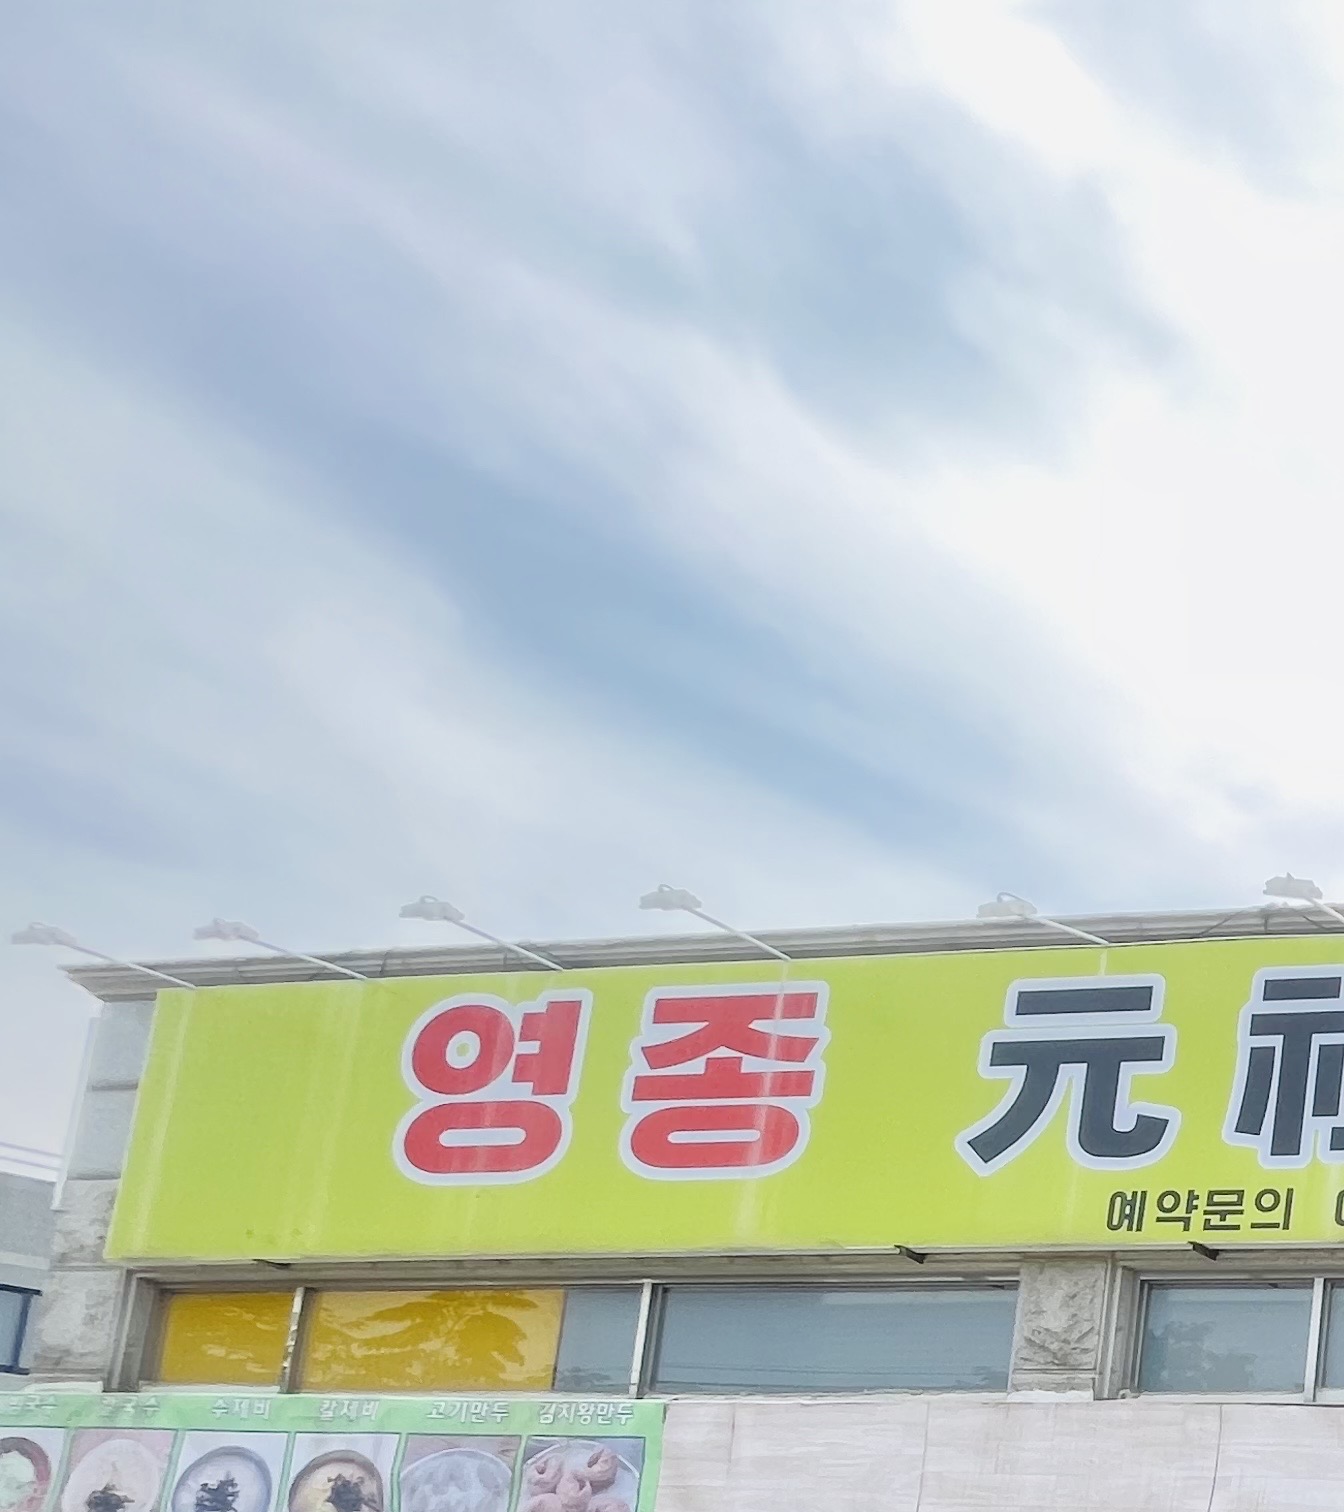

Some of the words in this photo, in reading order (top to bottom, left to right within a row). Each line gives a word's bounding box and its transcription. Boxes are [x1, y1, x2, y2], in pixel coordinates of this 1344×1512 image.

[400, 991, 818, 1177] 영종
[1106, 1187, 1294, 1233] 예약문의
[426, 1401, 509, 1423] 고기만두
[538, 1401, 634, 1425] 김치왕만두
